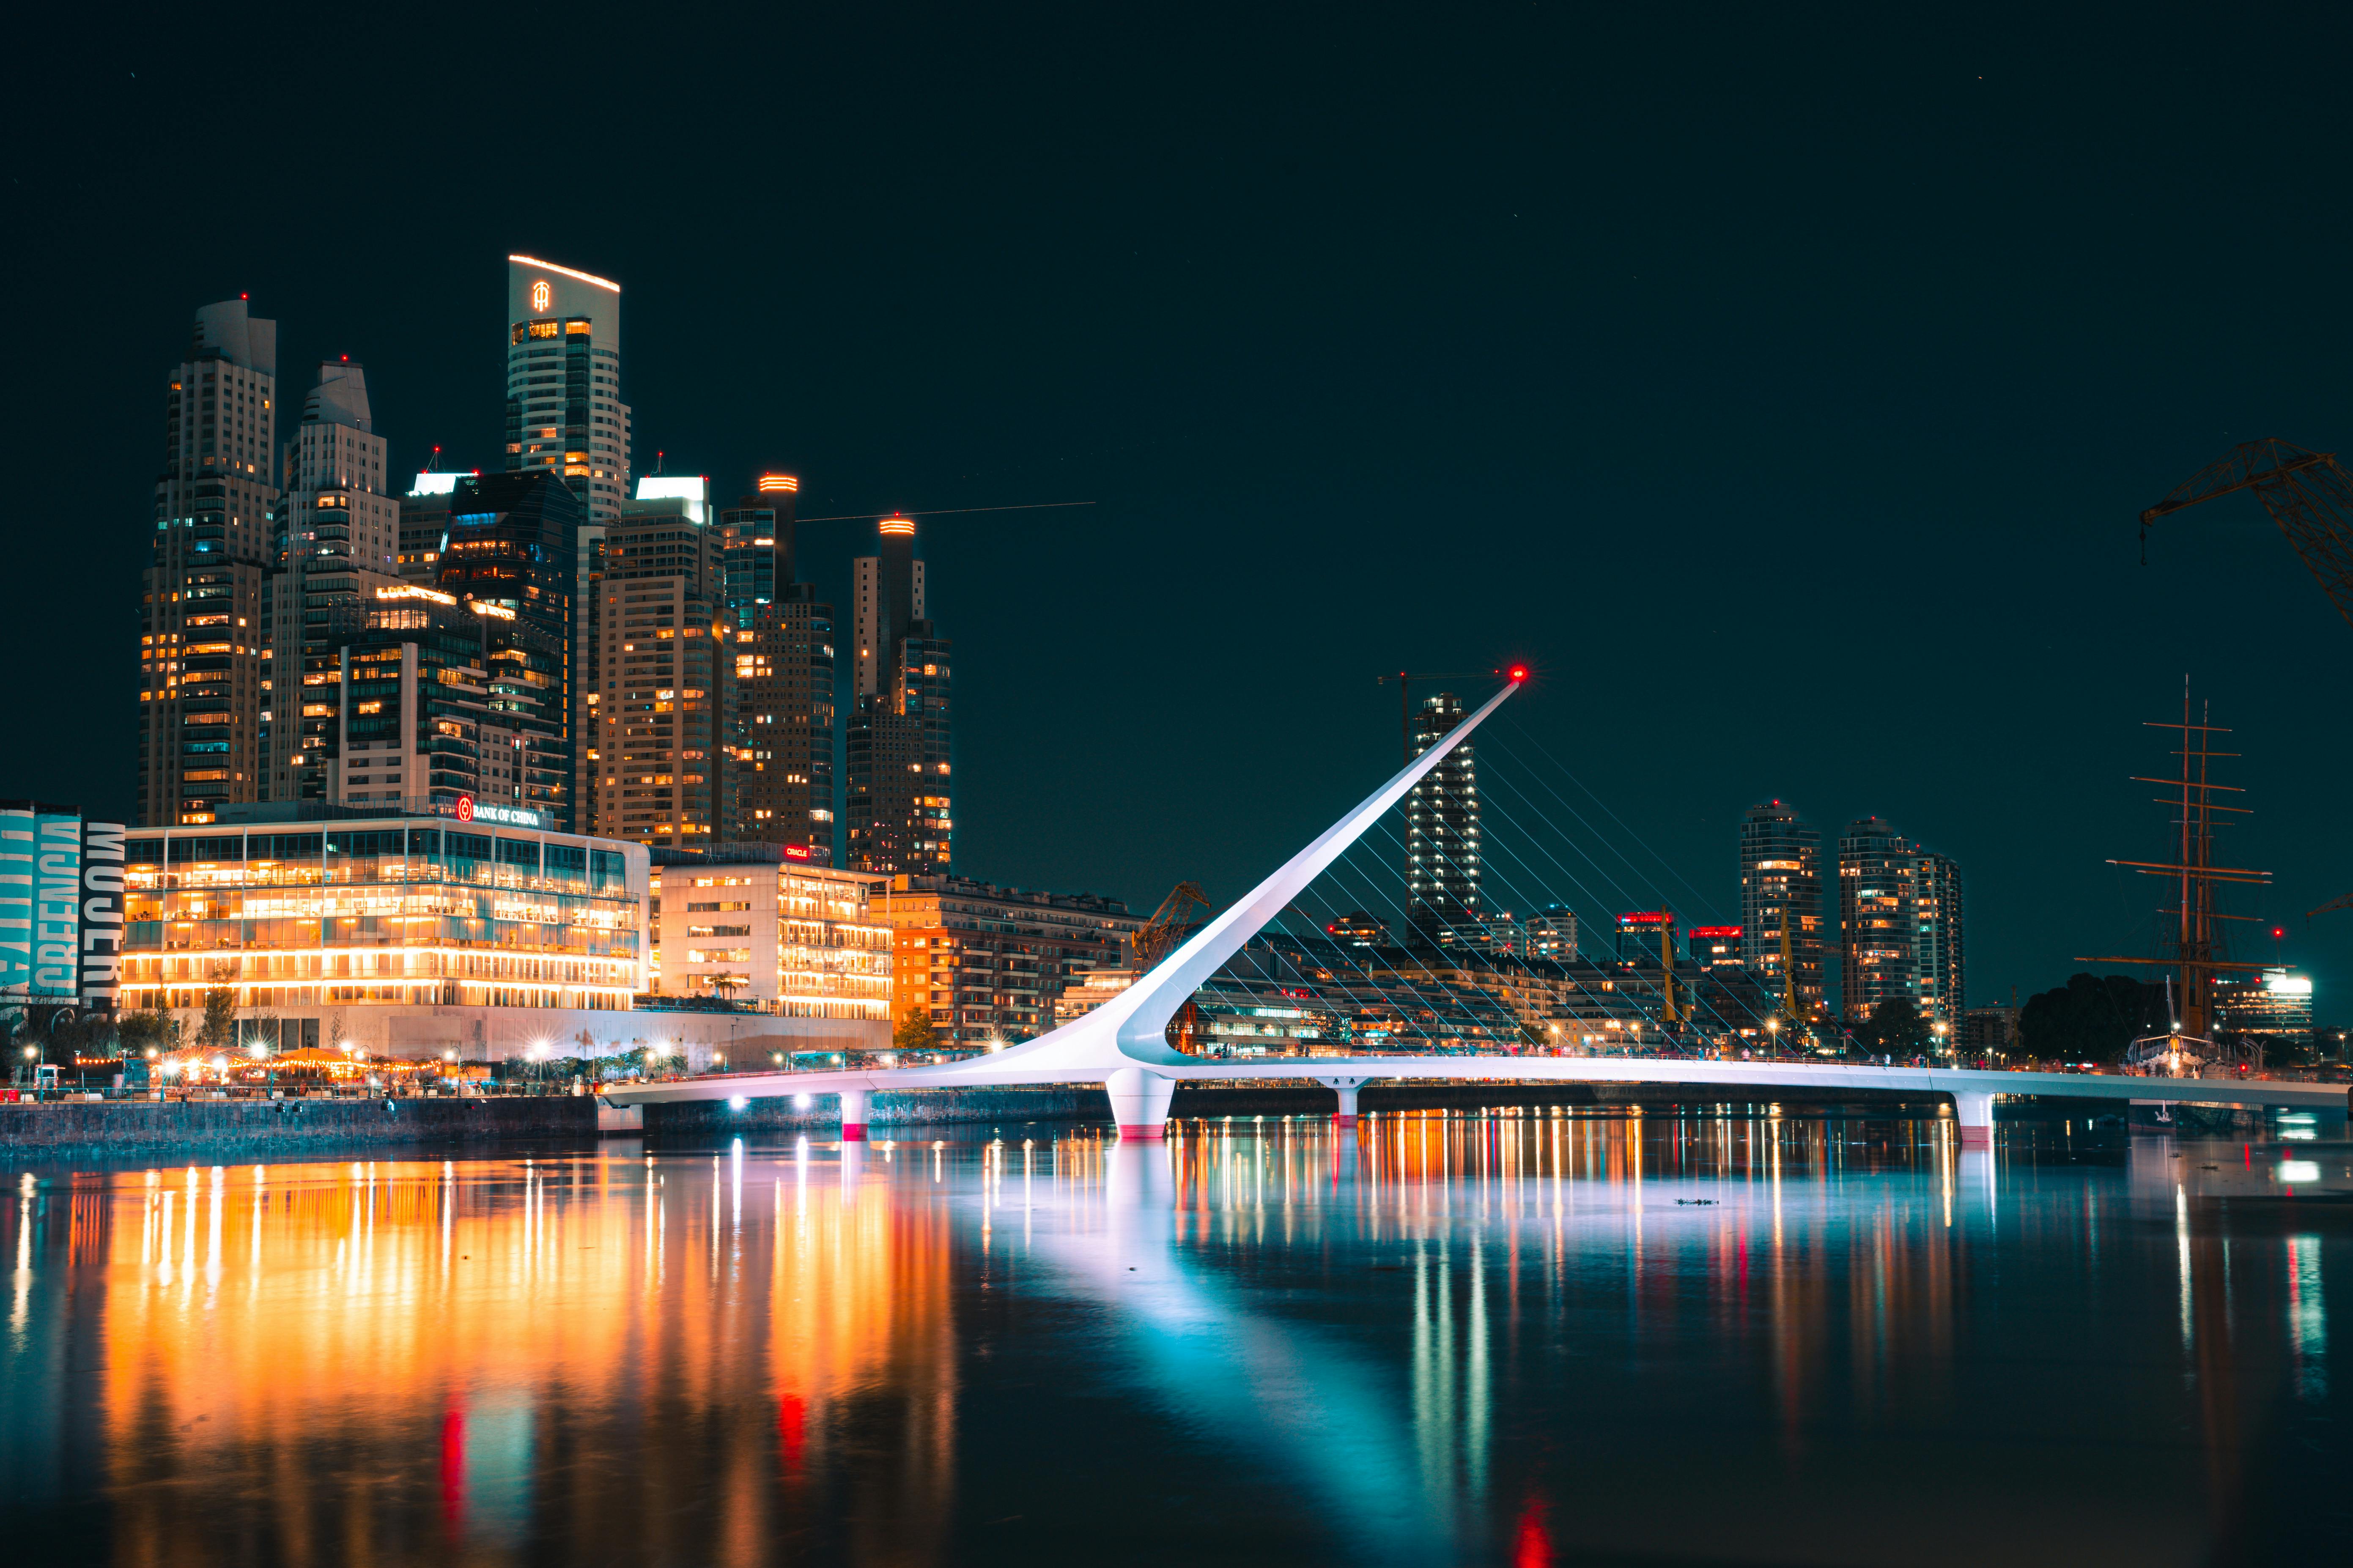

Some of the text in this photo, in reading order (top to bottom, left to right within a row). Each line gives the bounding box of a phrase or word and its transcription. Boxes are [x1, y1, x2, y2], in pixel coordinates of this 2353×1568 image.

[473, 806, 538, 825] BANK OF CHINA
[787, 848, 807, 857] ORACLE
[35, 822, 81, 989] CREENCIA
